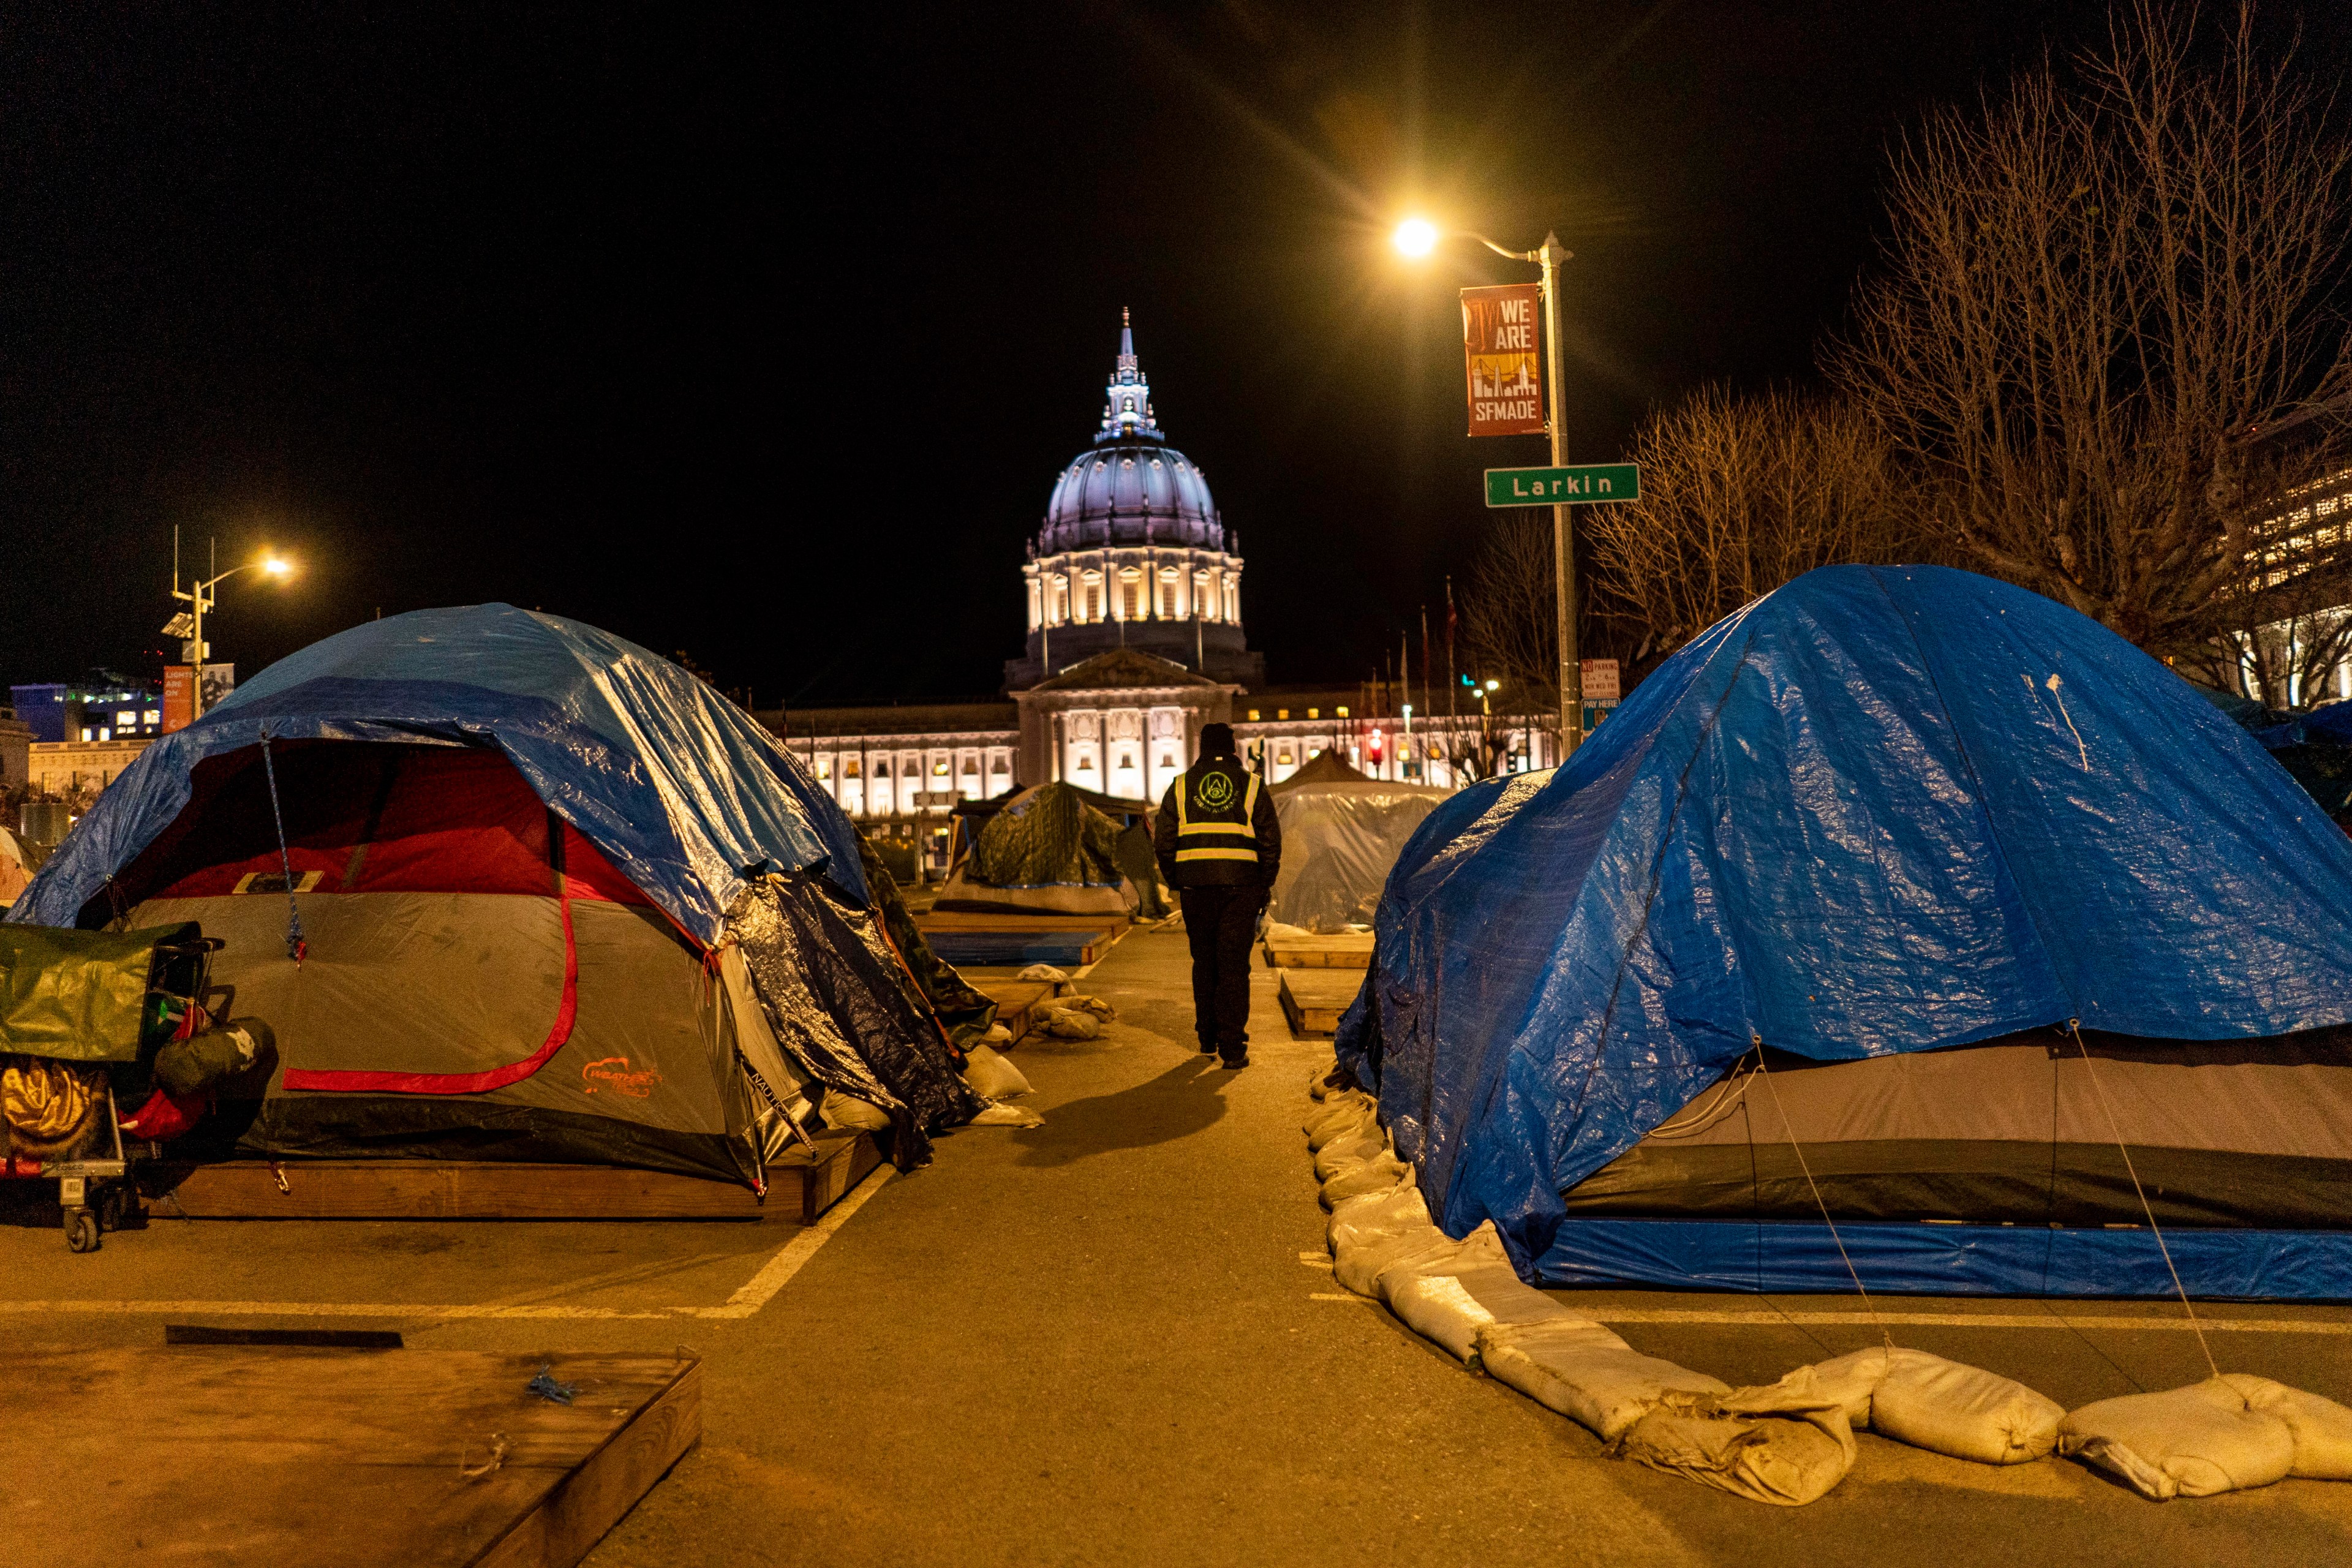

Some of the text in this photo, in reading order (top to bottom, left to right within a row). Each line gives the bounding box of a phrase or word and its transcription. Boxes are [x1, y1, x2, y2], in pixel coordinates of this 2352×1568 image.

[1500, 299, 1530, 324] WE
[1495, 325, 1532, 350] ARE
[1476, 400, 1537, 421] SFMADE
[1513, 475, 1611, 497] Larkin
[1582, 662, 1593, 671] NO
[1598, 699, 1618, 708] HERE
[1194, 796, 1211, 812] URBAN
[752, 1072, 788, 1121] NAUTICA
